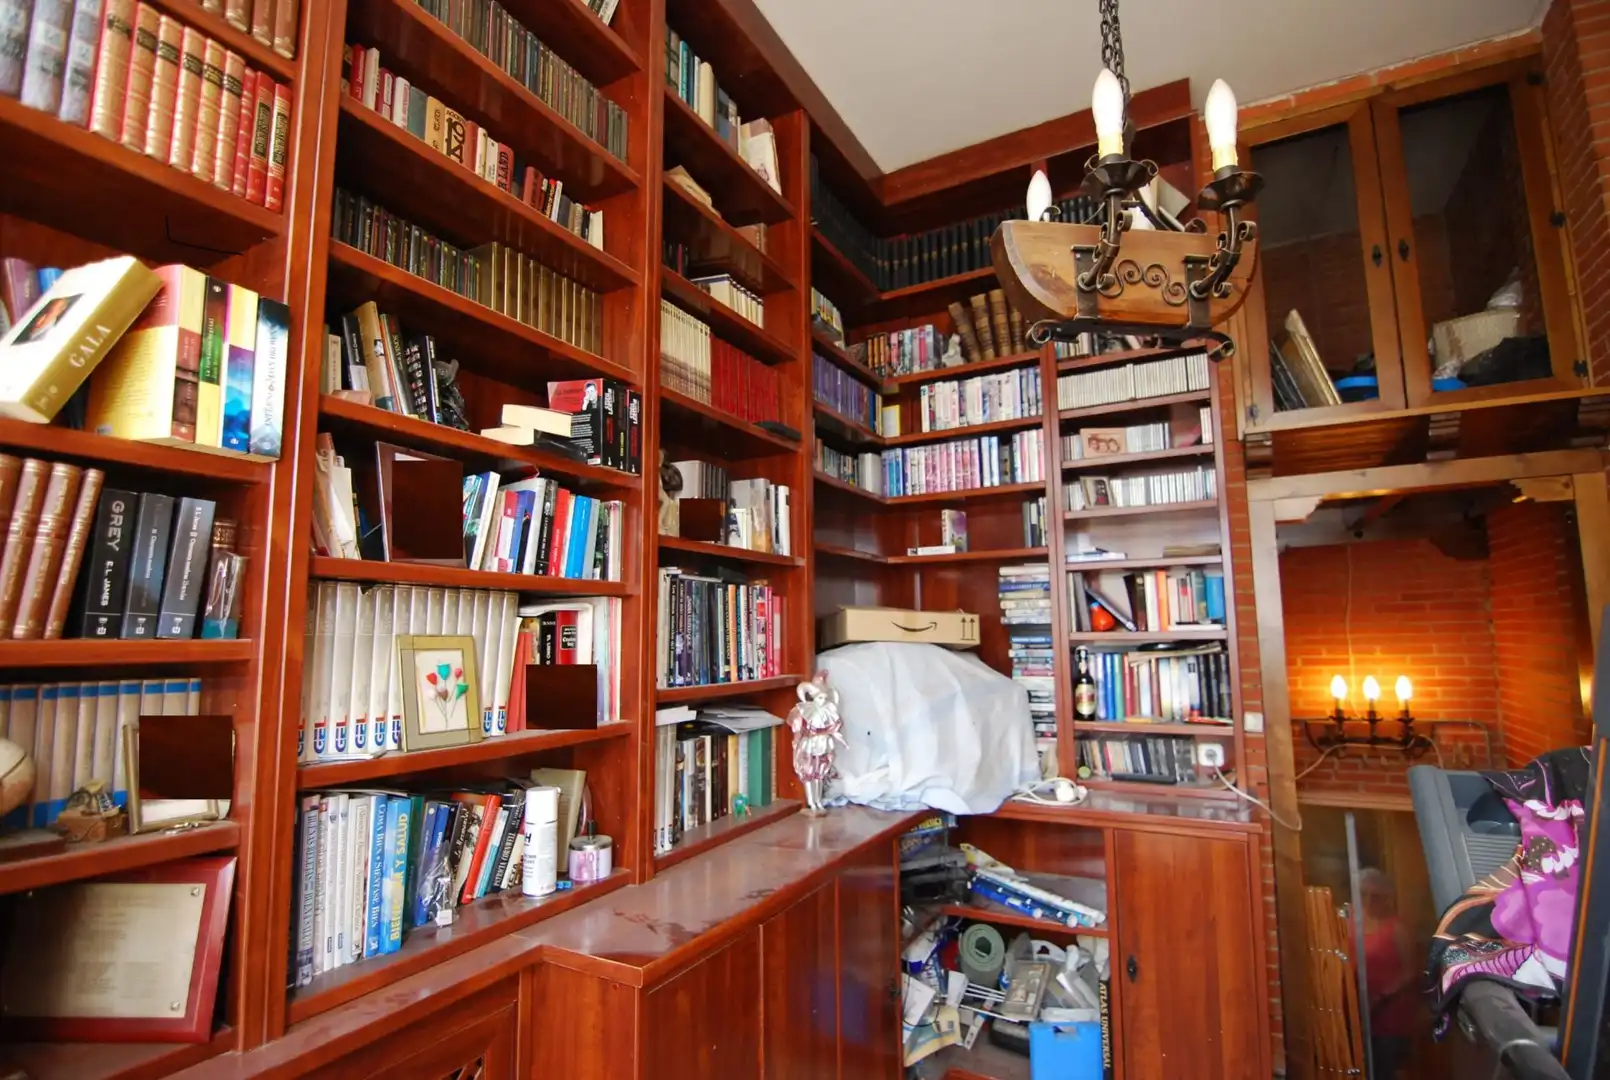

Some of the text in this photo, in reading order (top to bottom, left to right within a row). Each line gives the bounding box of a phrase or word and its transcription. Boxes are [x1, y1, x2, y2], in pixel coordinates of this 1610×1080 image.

[68, 326, 112, 369] GALA
[107, 500, 125, 552] GREY
[101, 577, 111, 606] JAMES
[313, 716, 326, 754] GEL
[336, 715, 347, 753] GEL
[355, 713, 367, 749] GEL
[374, 711, 385, 746] GEL
[483, 703, 493, 733] GEL
[377, 804, 386, 830] COMA
[396, 813, 409, 855] SALUD
[376, 832, 385, 854] BIEN
[493, 832, 515, 887] PATRICIA CORNWELL
[394, 859, 405, 870] Y
[370, 904, 381, 928] BIEN
[1099, 982, 1111, 1070] ATLAS UNIVERSAL
